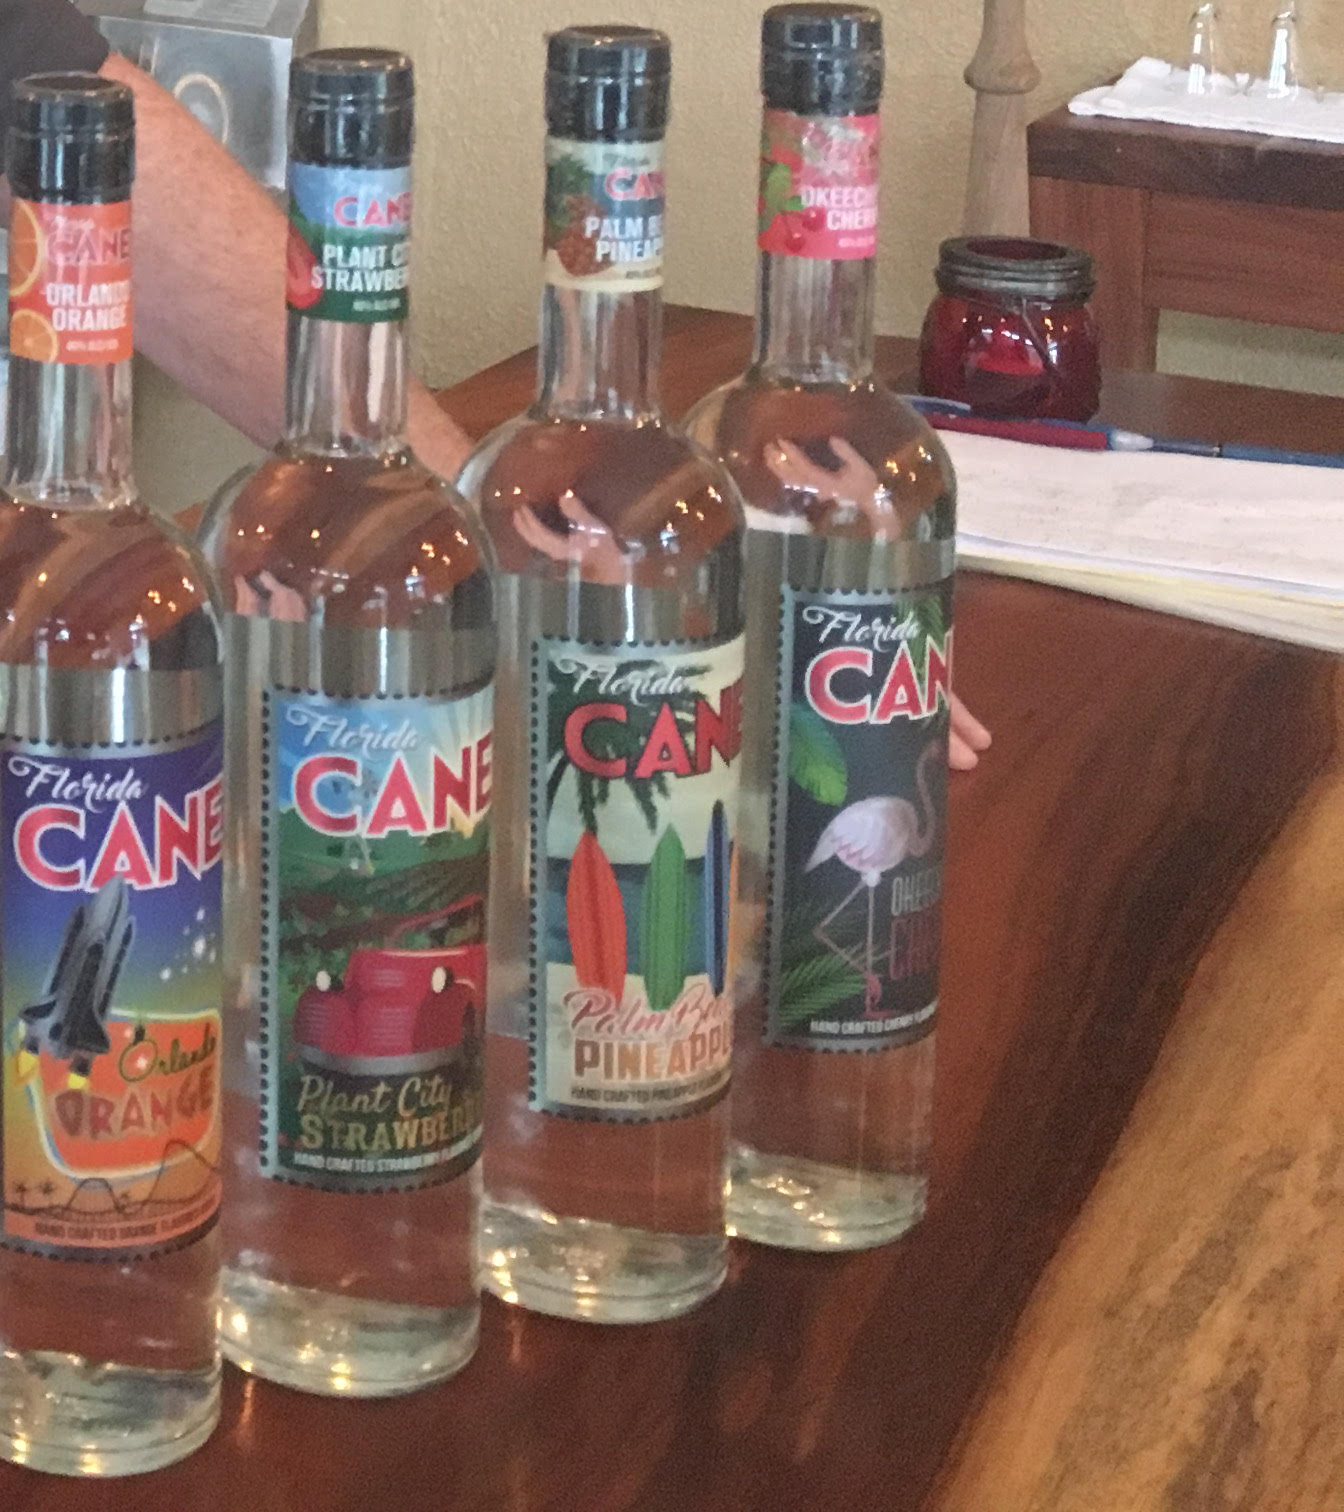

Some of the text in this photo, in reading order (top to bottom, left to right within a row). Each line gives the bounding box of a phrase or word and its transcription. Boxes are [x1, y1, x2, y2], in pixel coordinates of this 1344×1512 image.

[585, 215, 644, 239] PALM
[323, 245, 387, 269] PLANT
[803, 606, 921, 654] Florida
[557, 657, 690, 708] Florida
[804, 625, 954, 725] CAN
[286, 705, 419, 761] Florida
[8, 756, 148, 814] Florida
[291, 728, 493, 838] CANE
[13, 772, 224, 893] CANE
[574, 1021, 730, 1080] PINEAPPL
[54, 1062, 213, 1141] ORANGE
[297, 1073, 454, 1117] Plant City
